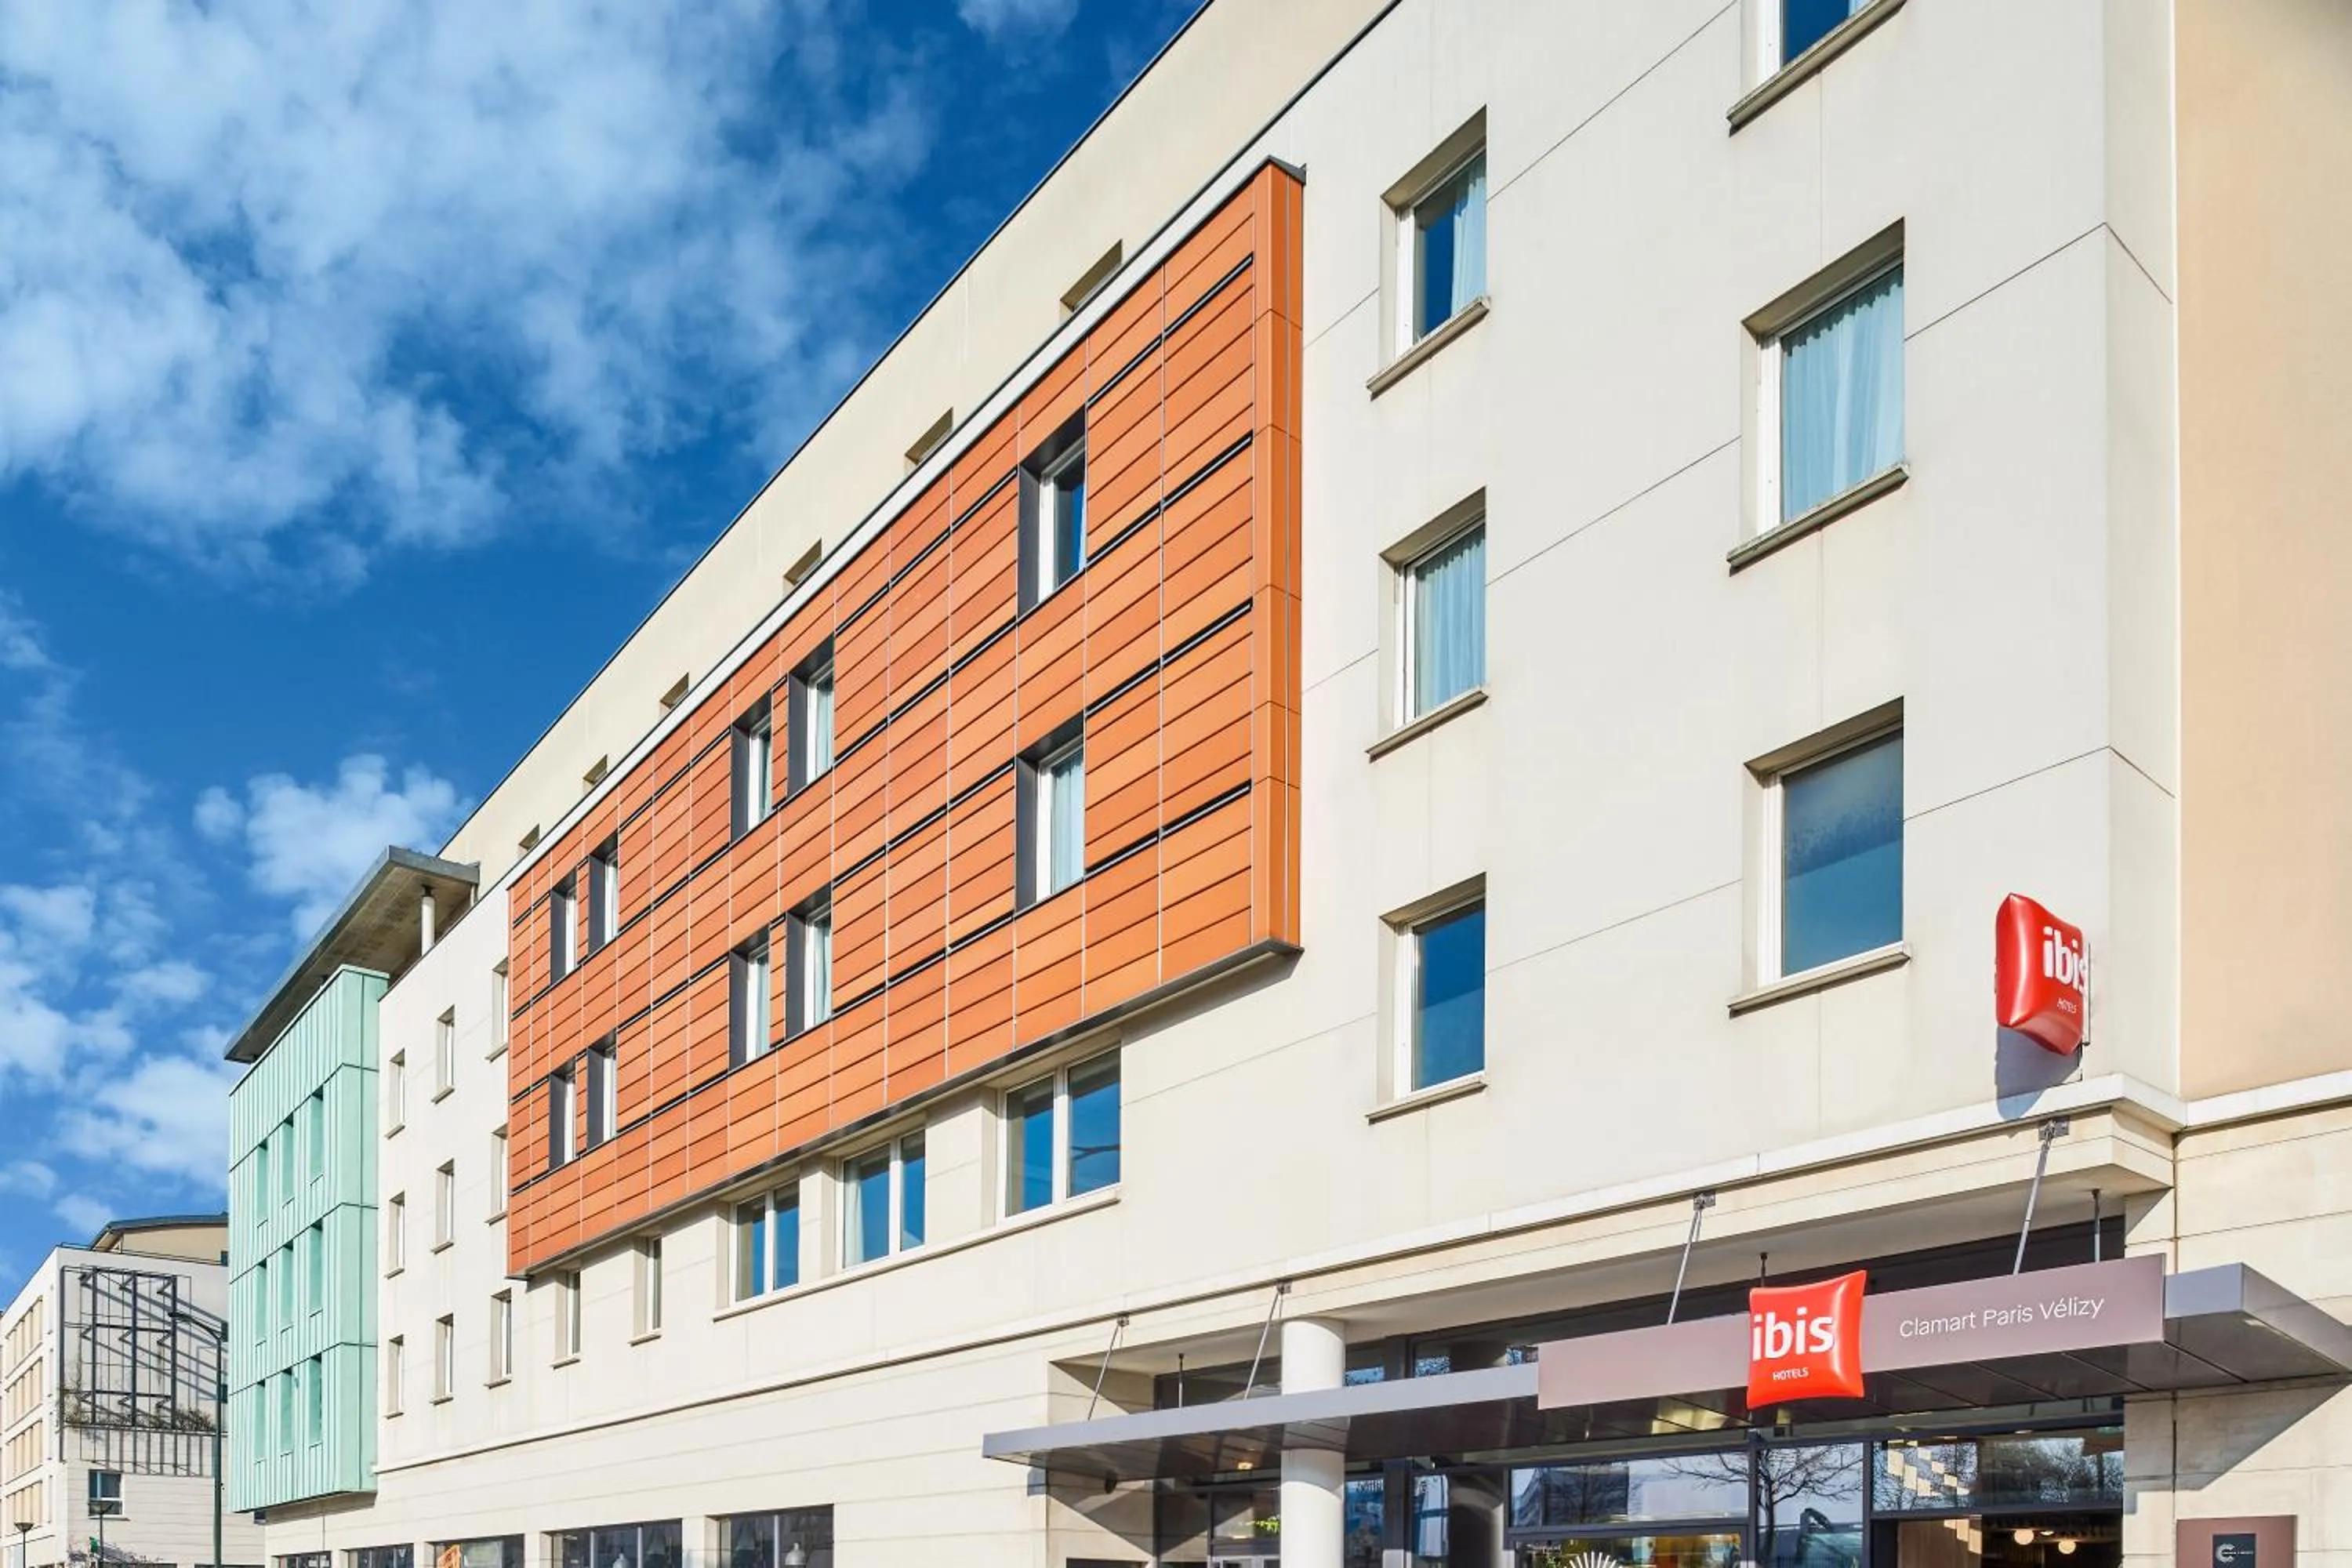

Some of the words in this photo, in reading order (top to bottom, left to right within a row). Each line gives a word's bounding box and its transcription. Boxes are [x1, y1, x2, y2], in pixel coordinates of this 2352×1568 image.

[1752, 1306, 1835, 1362] ibis
[1900, 1312, 1976, 1337] Clamart
[1983, 1304, 2033, 1327] Paris
[2039, 1296, 2104, 1319] Vélizy
[1773, 1367, 1809, 1381] HOTELS
